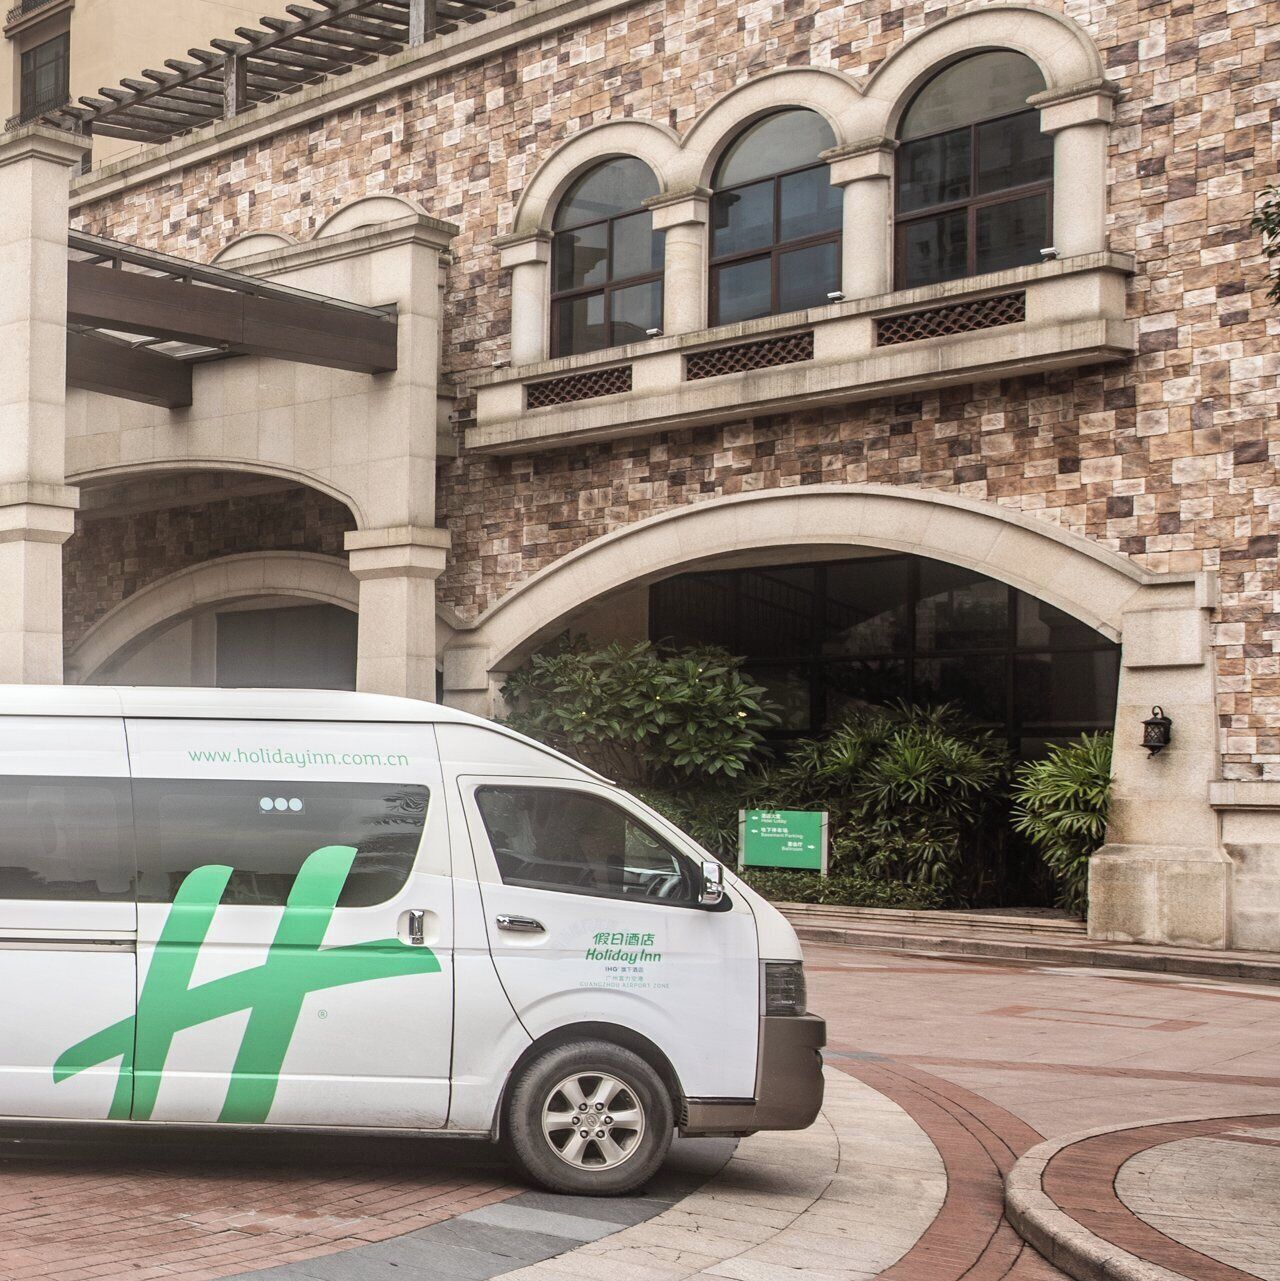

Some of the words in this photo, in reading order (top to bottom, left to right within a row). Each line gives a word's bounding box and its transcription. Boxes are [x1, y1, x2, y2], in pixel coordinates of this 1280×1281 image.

[188, 747, 409, 768] www.holidayinn.com.cn
[592, 932, 655, 946] 假日酒店
[585, 948, 638, 965] Holiday
[639, 948, 662, 962] Inn
